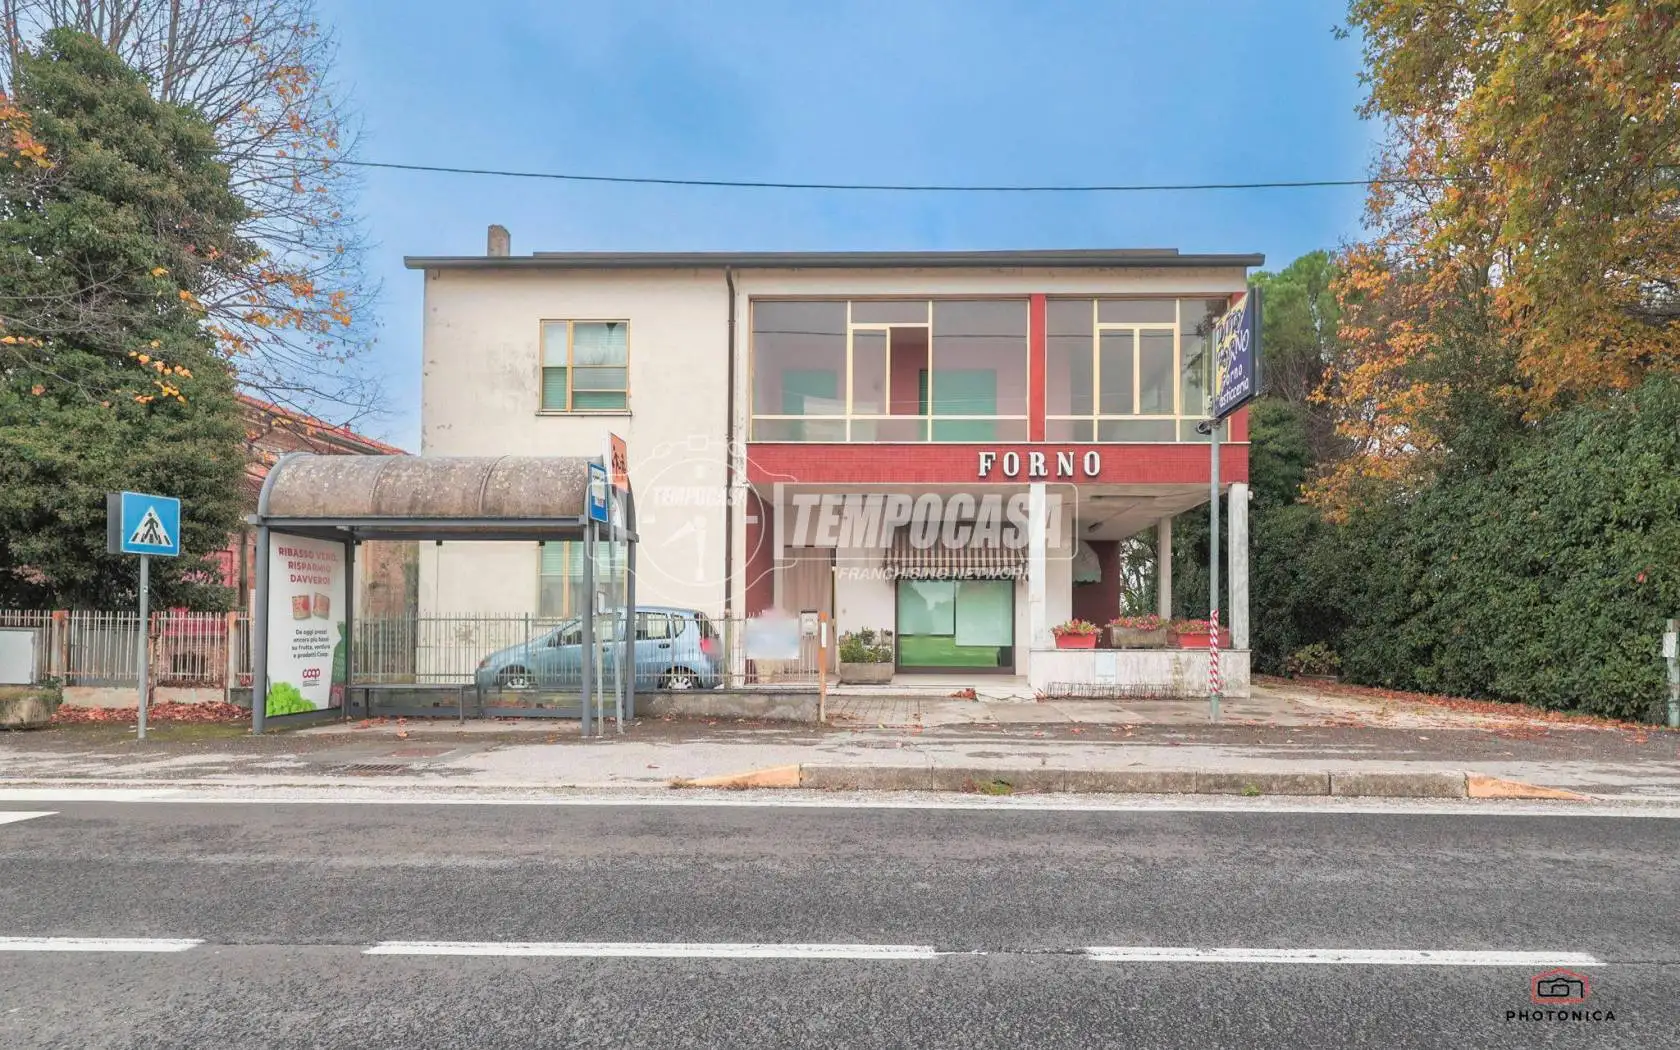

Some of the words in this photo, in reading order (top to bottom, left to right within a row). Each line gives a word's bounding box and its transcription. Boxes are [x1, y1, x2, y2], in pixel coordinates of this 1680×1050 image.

[977, 451, 1101, 477] FORNO
[278, 547, 314, 559] RIBASSO
[288, 561, 331, 573] RISPARMIO
[302, 668, 321, 680] coop
